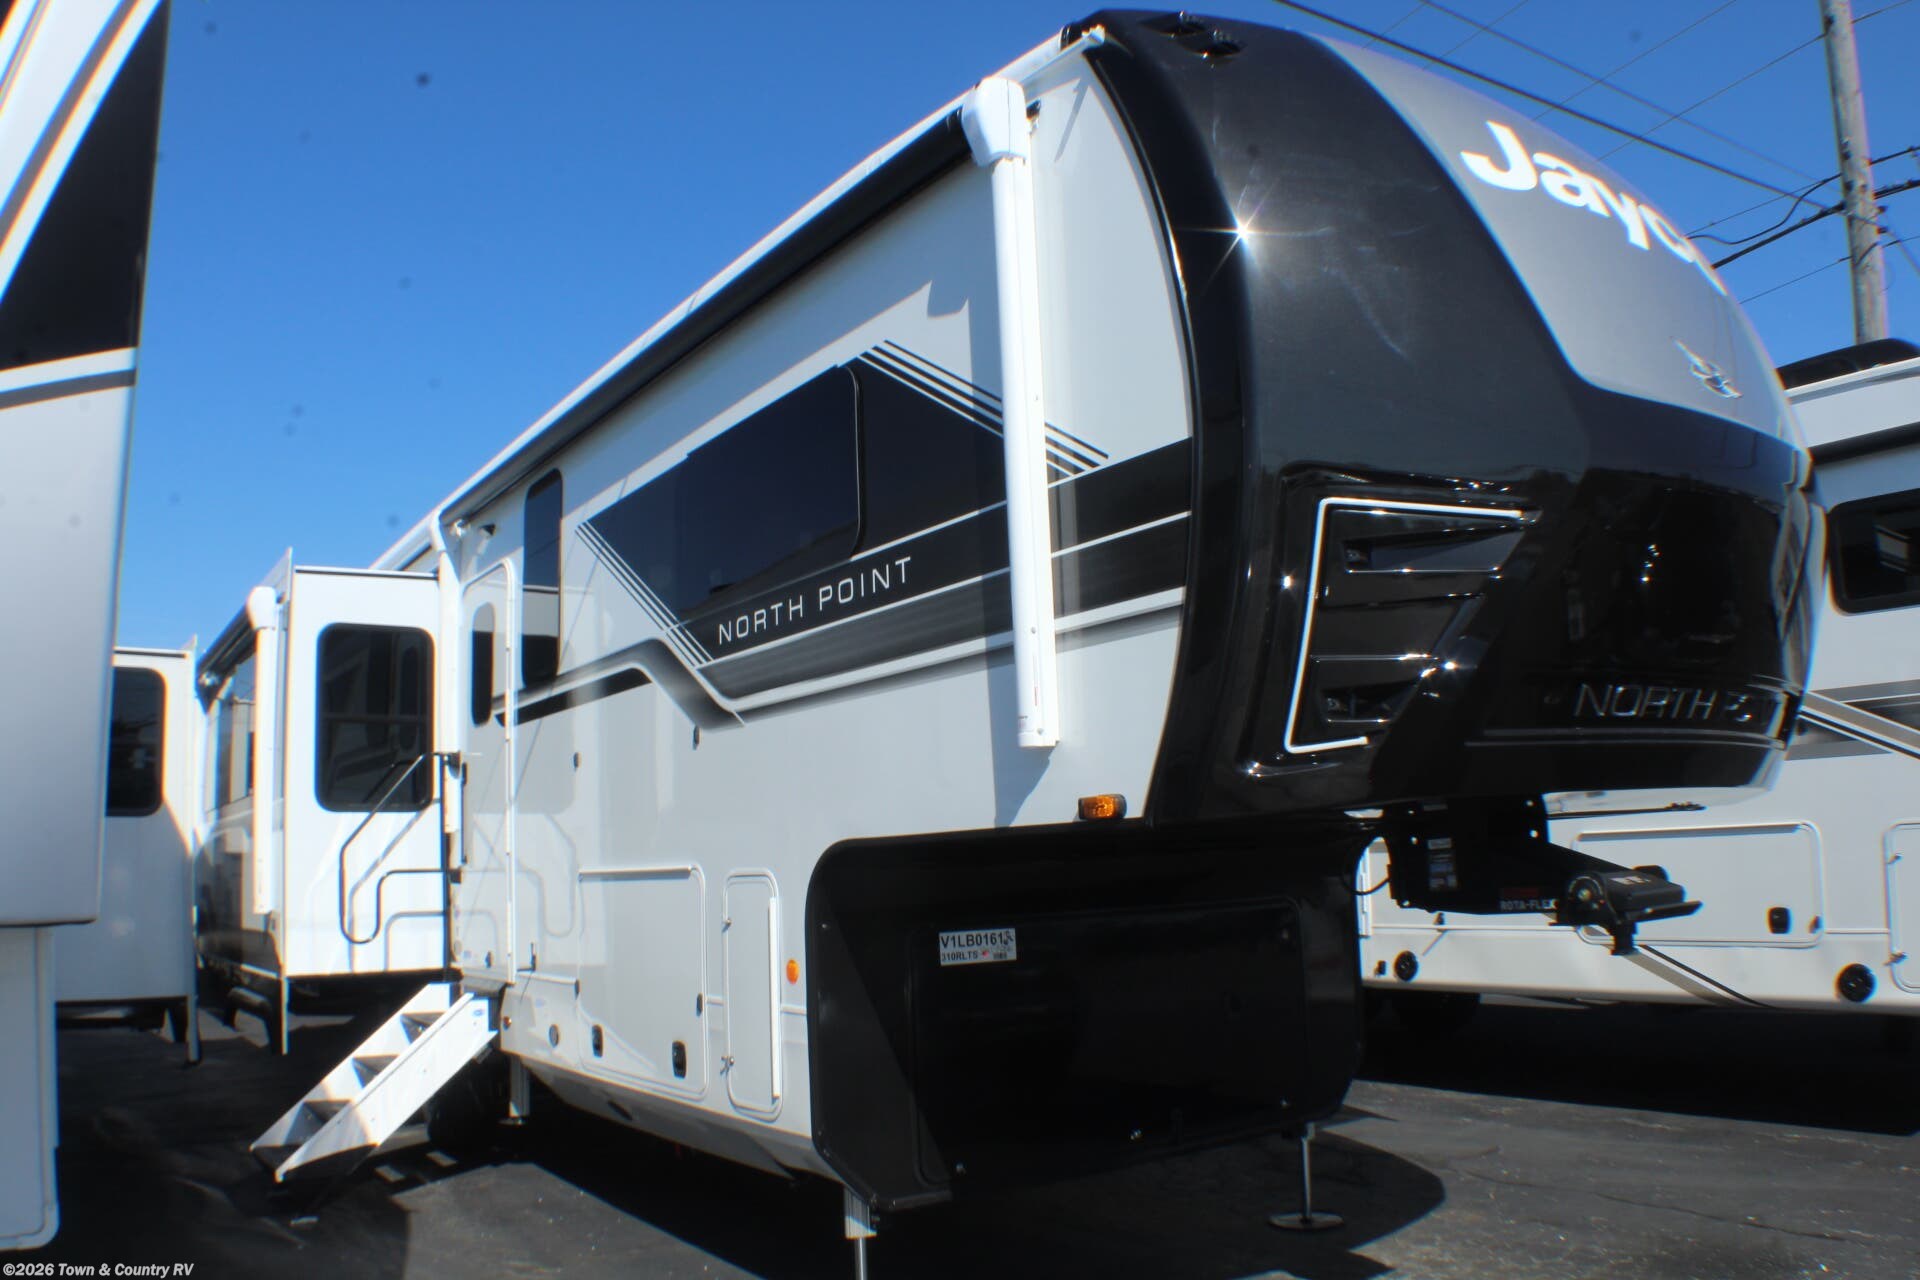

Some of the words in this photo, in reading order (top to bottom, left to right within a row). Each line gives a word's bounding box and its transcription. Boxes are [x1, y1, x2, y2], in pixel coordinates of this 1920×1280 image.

[1460, 120, 1727, 296] Jayc
[718, 594, 804, 645] NORTH
[818, 556, 912, 612] POINT
[1574, 682, 1718, 721] NORTH
